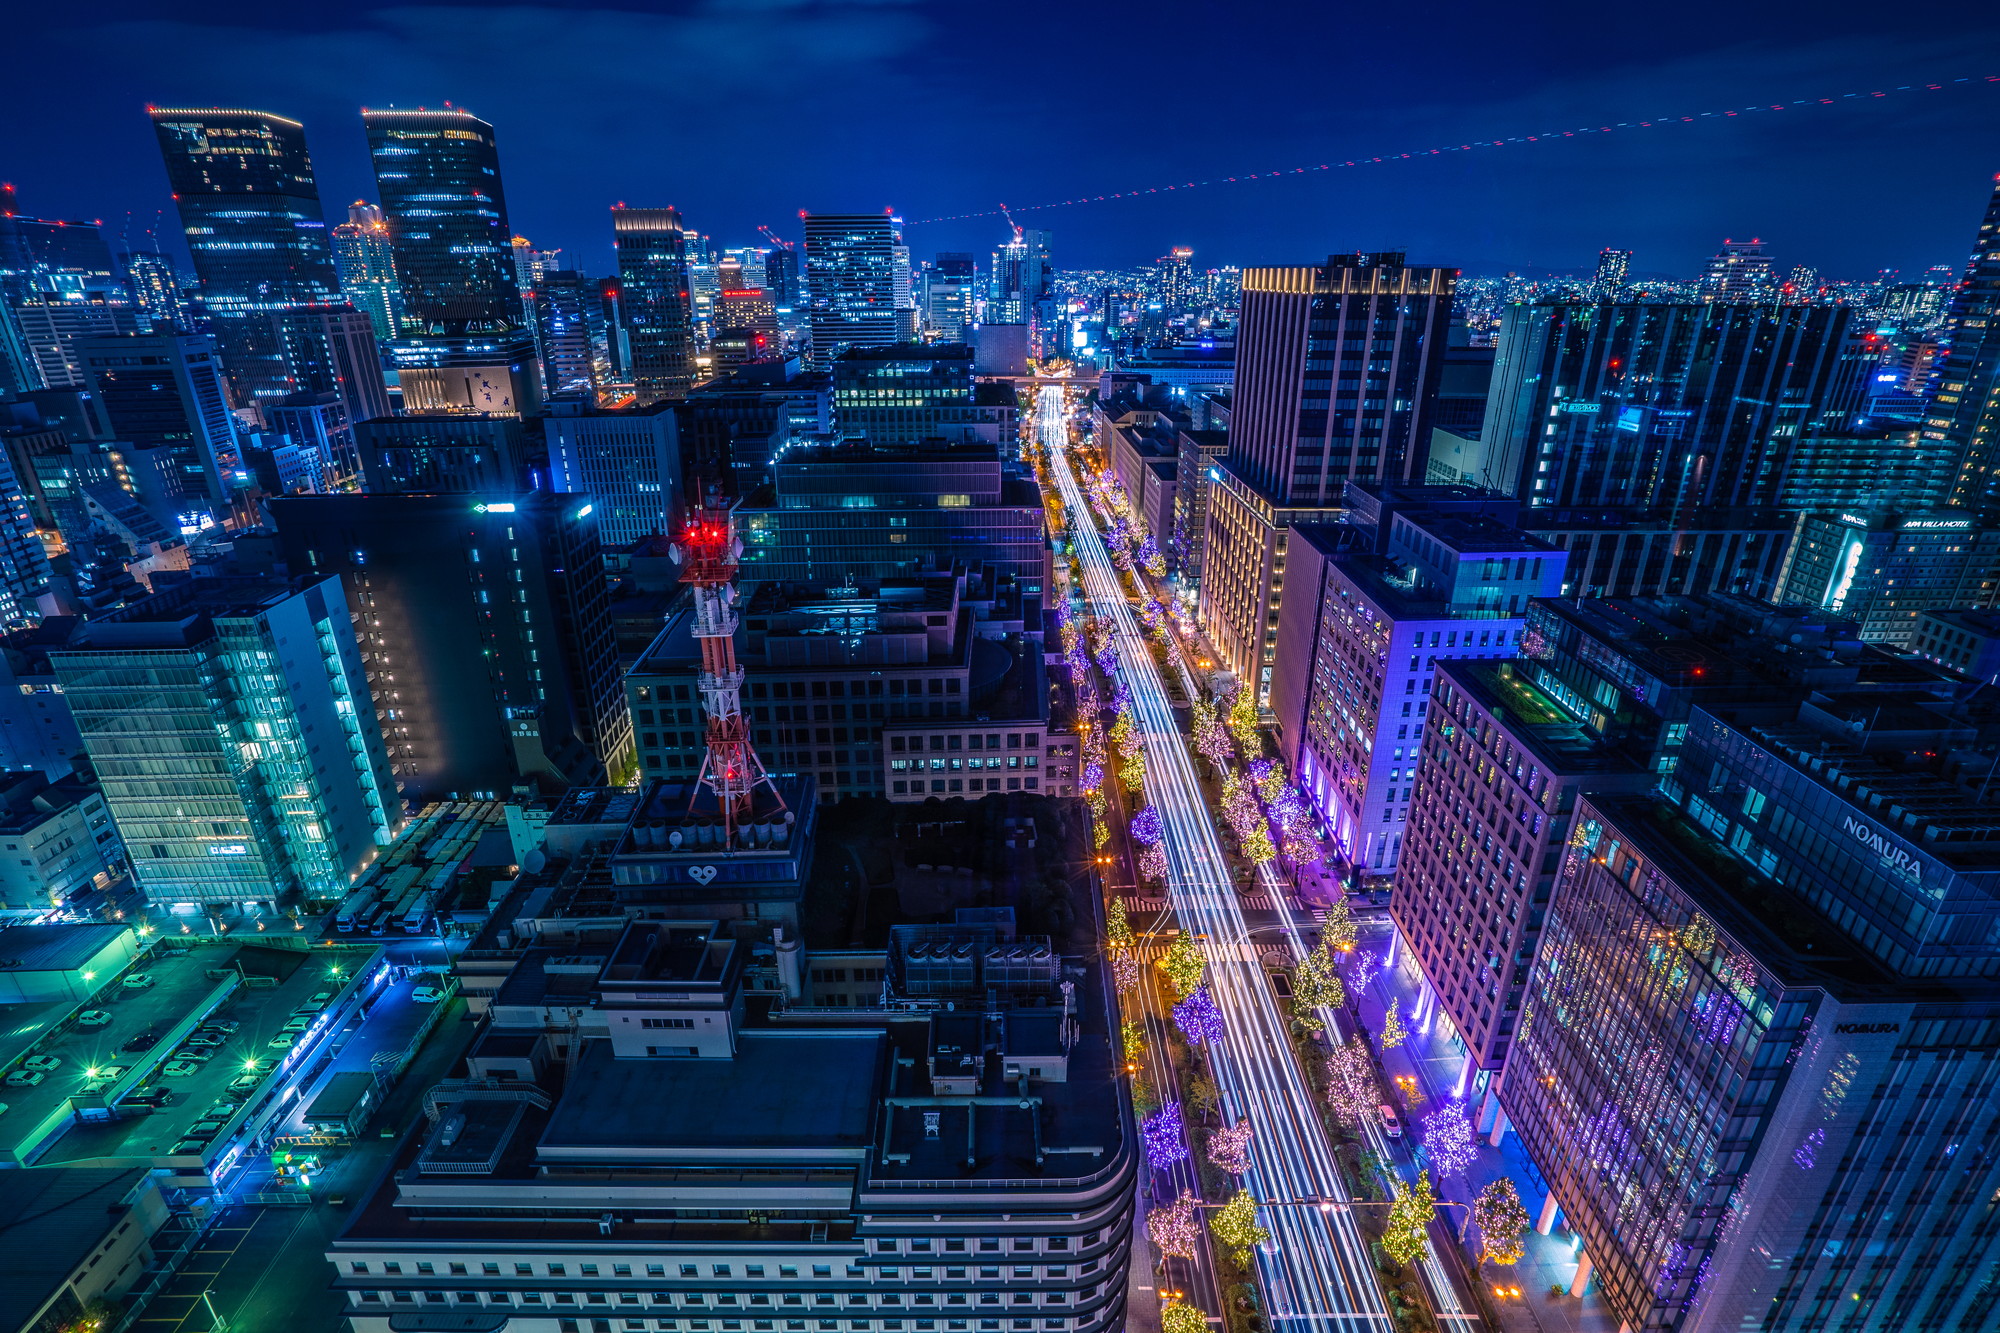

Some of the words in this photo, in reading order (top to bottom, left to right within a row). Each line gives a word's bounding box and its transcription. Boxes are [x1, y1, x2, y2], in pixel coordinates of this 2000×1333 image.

[1842, 513, 1857, 523] APA
[1944, 520, 1969, 528] HOTEL
[1843, 815, 1921, 879] NOMURA
[1835, 1023, 1899, 1034] NOMURA
